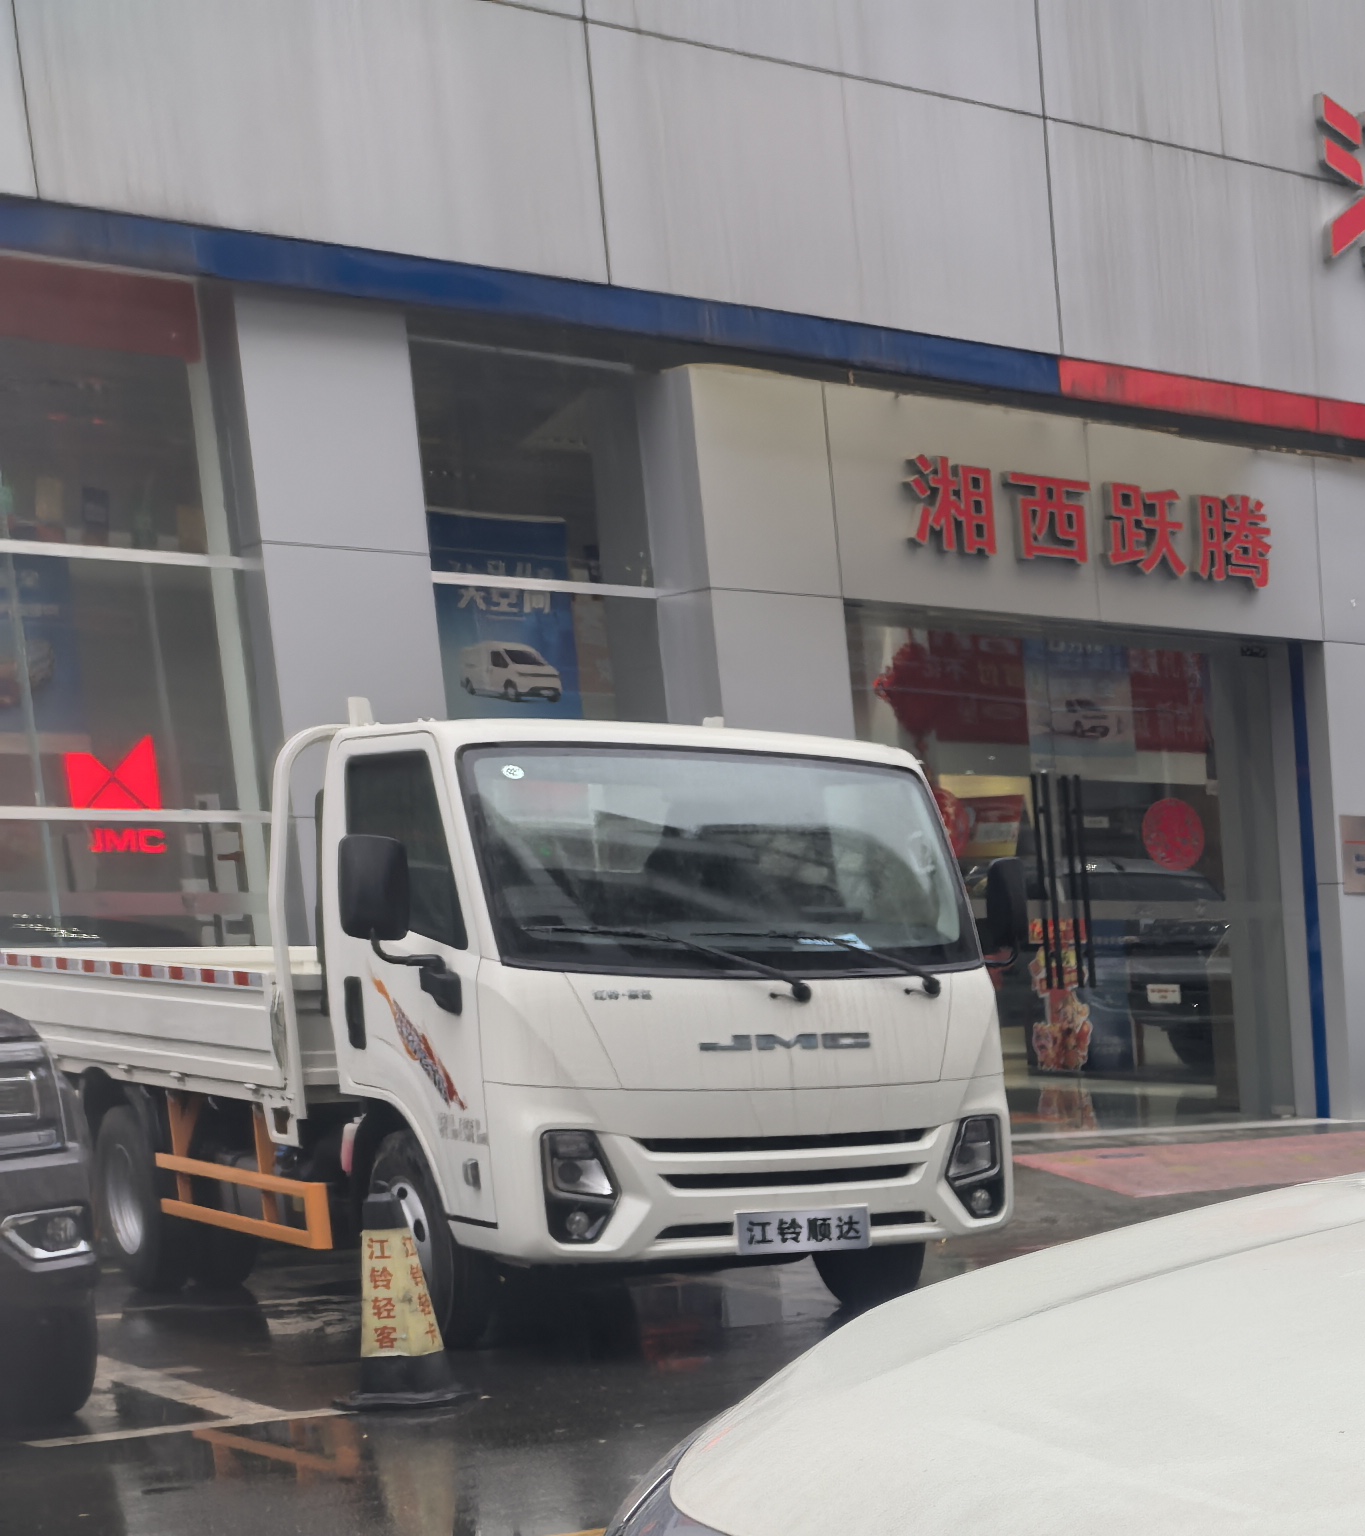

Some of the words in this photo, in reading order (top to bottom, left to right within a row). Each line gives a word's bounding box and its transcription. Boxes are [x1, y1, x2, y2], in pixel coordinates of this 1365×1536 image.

[903, 454, 1272, 588] 湘西跃腾
[91, 828, 167, 854] JMC
[699, 1032, 870, 1051] JMC
[746, 1214, 862, 1245] 江铃顺达
[367, 1237, 398, 1349] 江铃轻客
